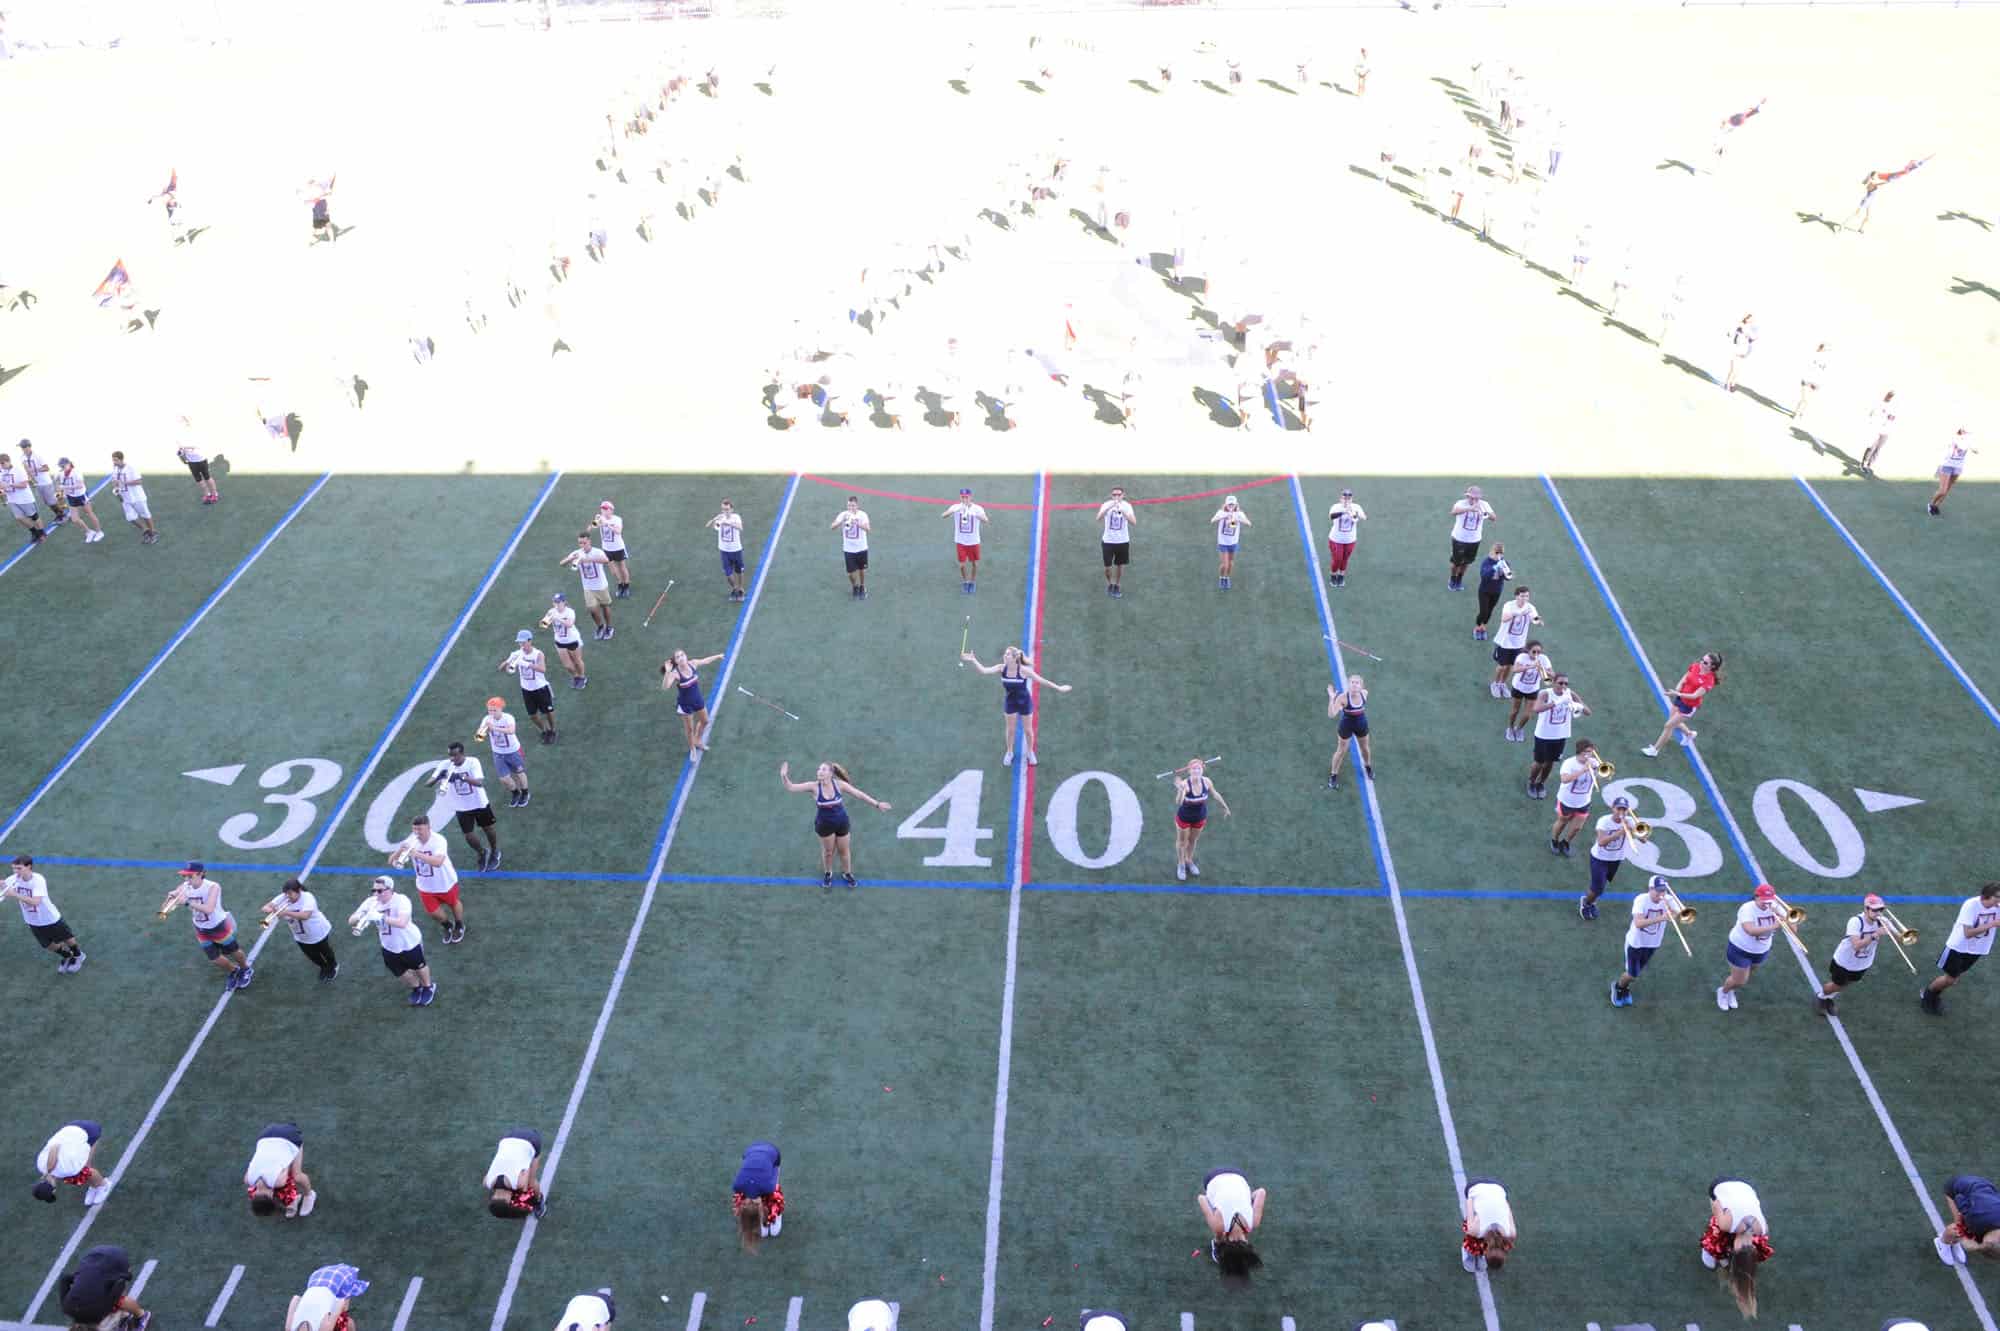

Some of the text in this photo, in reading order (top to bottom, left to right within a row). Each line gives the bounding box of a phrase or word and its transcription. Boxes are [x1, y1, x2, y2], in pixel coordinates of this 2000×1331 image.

[218, 757, 459, 854] 30
[896, 768, 1144, 870] 40
[1601, 777, 1866, 879] 30
